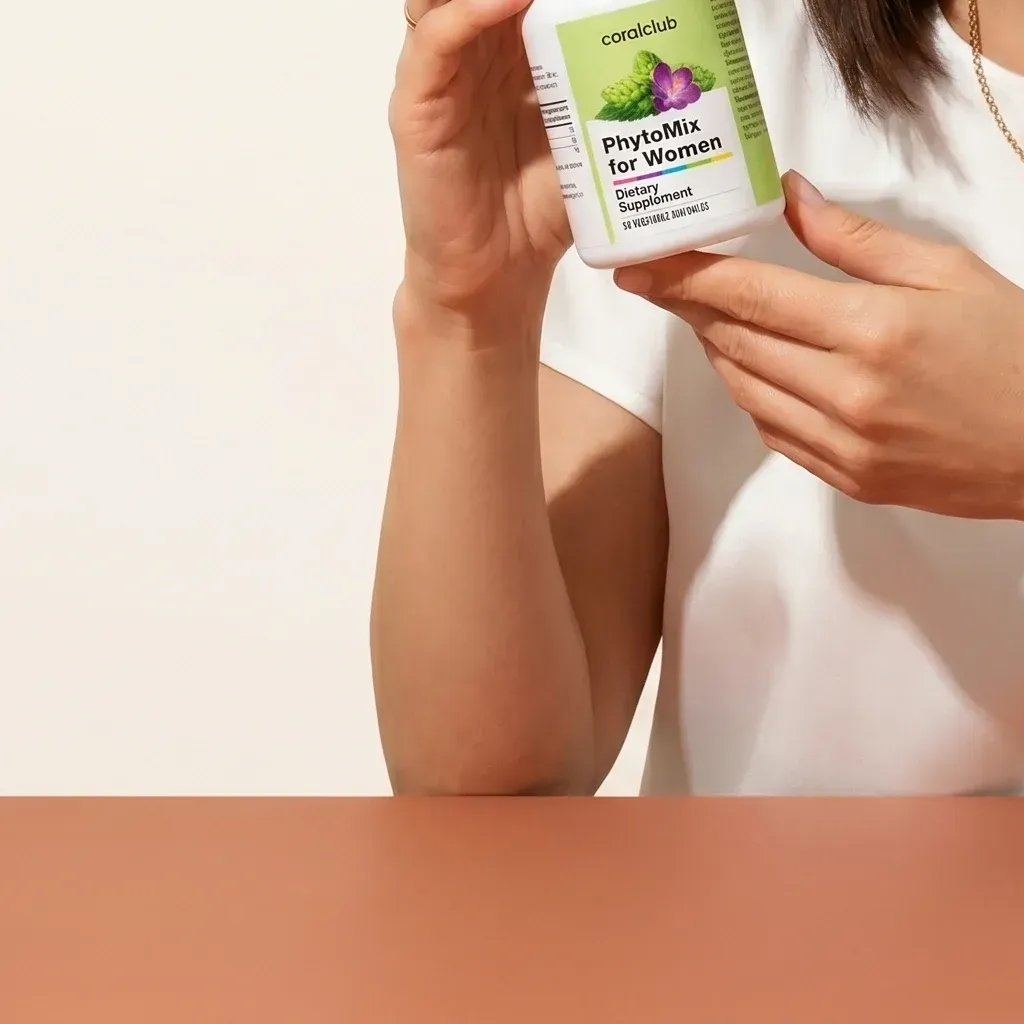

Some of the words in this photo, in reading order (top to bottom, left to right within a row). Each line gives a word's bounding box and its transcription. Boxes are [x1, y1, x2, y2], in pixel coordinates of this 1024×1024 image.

[601, 16, 677, 45] coralclub
[602, 117, 701, 154] PhytoMix
[608, 159, 638, 175] for
[642, 136, 722, 167] Women
[615, 183, 659, 200] Dietary
